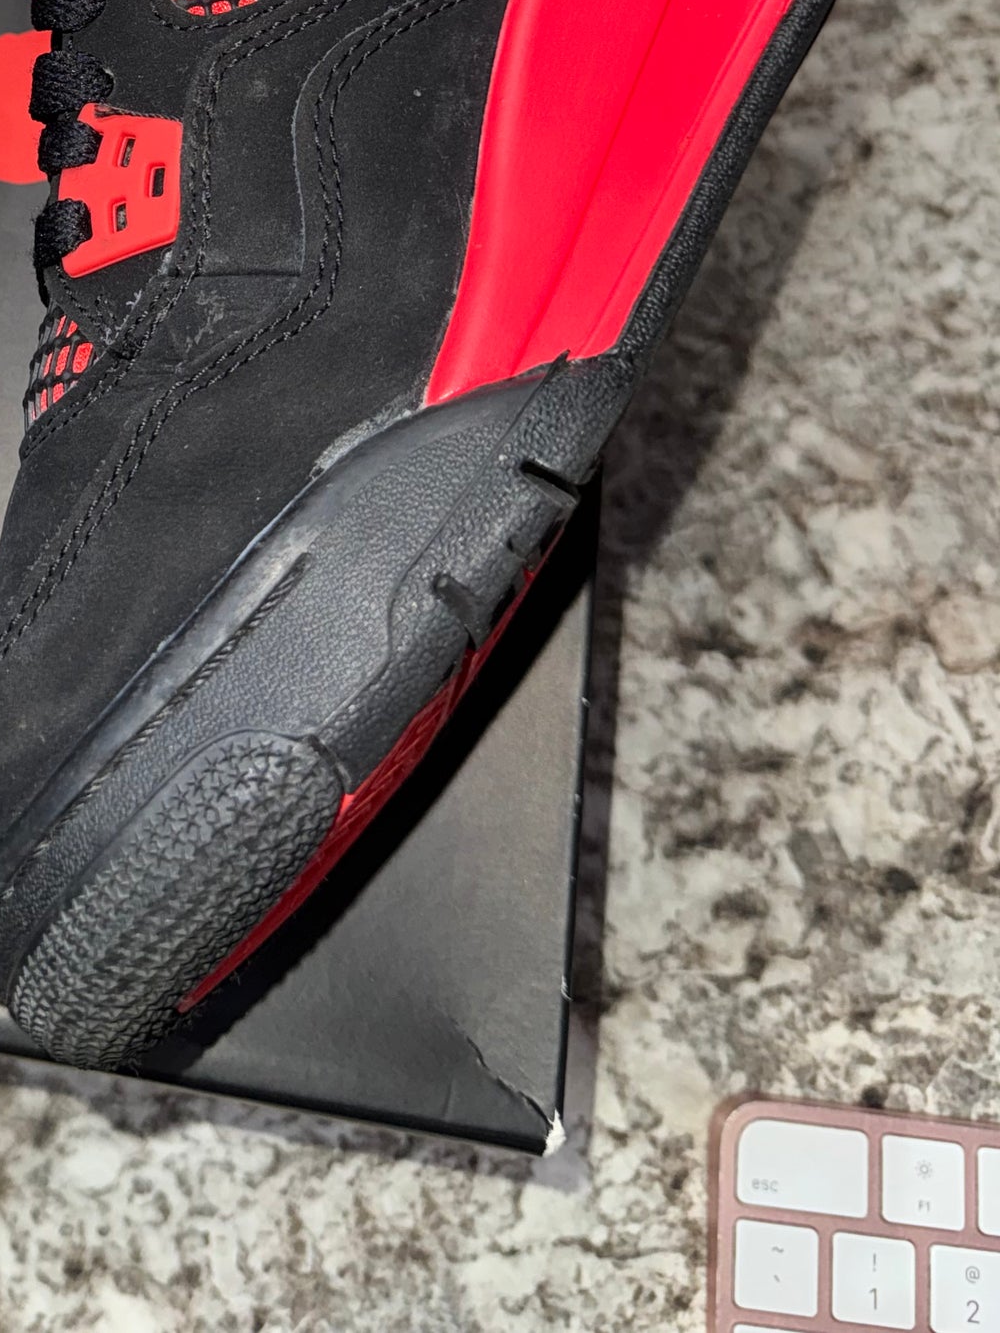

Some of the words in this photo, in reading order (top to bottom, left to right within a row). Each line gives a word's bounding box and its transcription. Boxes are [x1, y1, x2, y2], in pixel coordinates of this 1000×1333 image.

[751, 1177, 779, 1193] esc
[918, 1199, 931, 1212] F1
[965, 1265, 981, 1284] @
[869, 1287, 878, 1311] 1
[966, 1299, 981, 1325] 2
